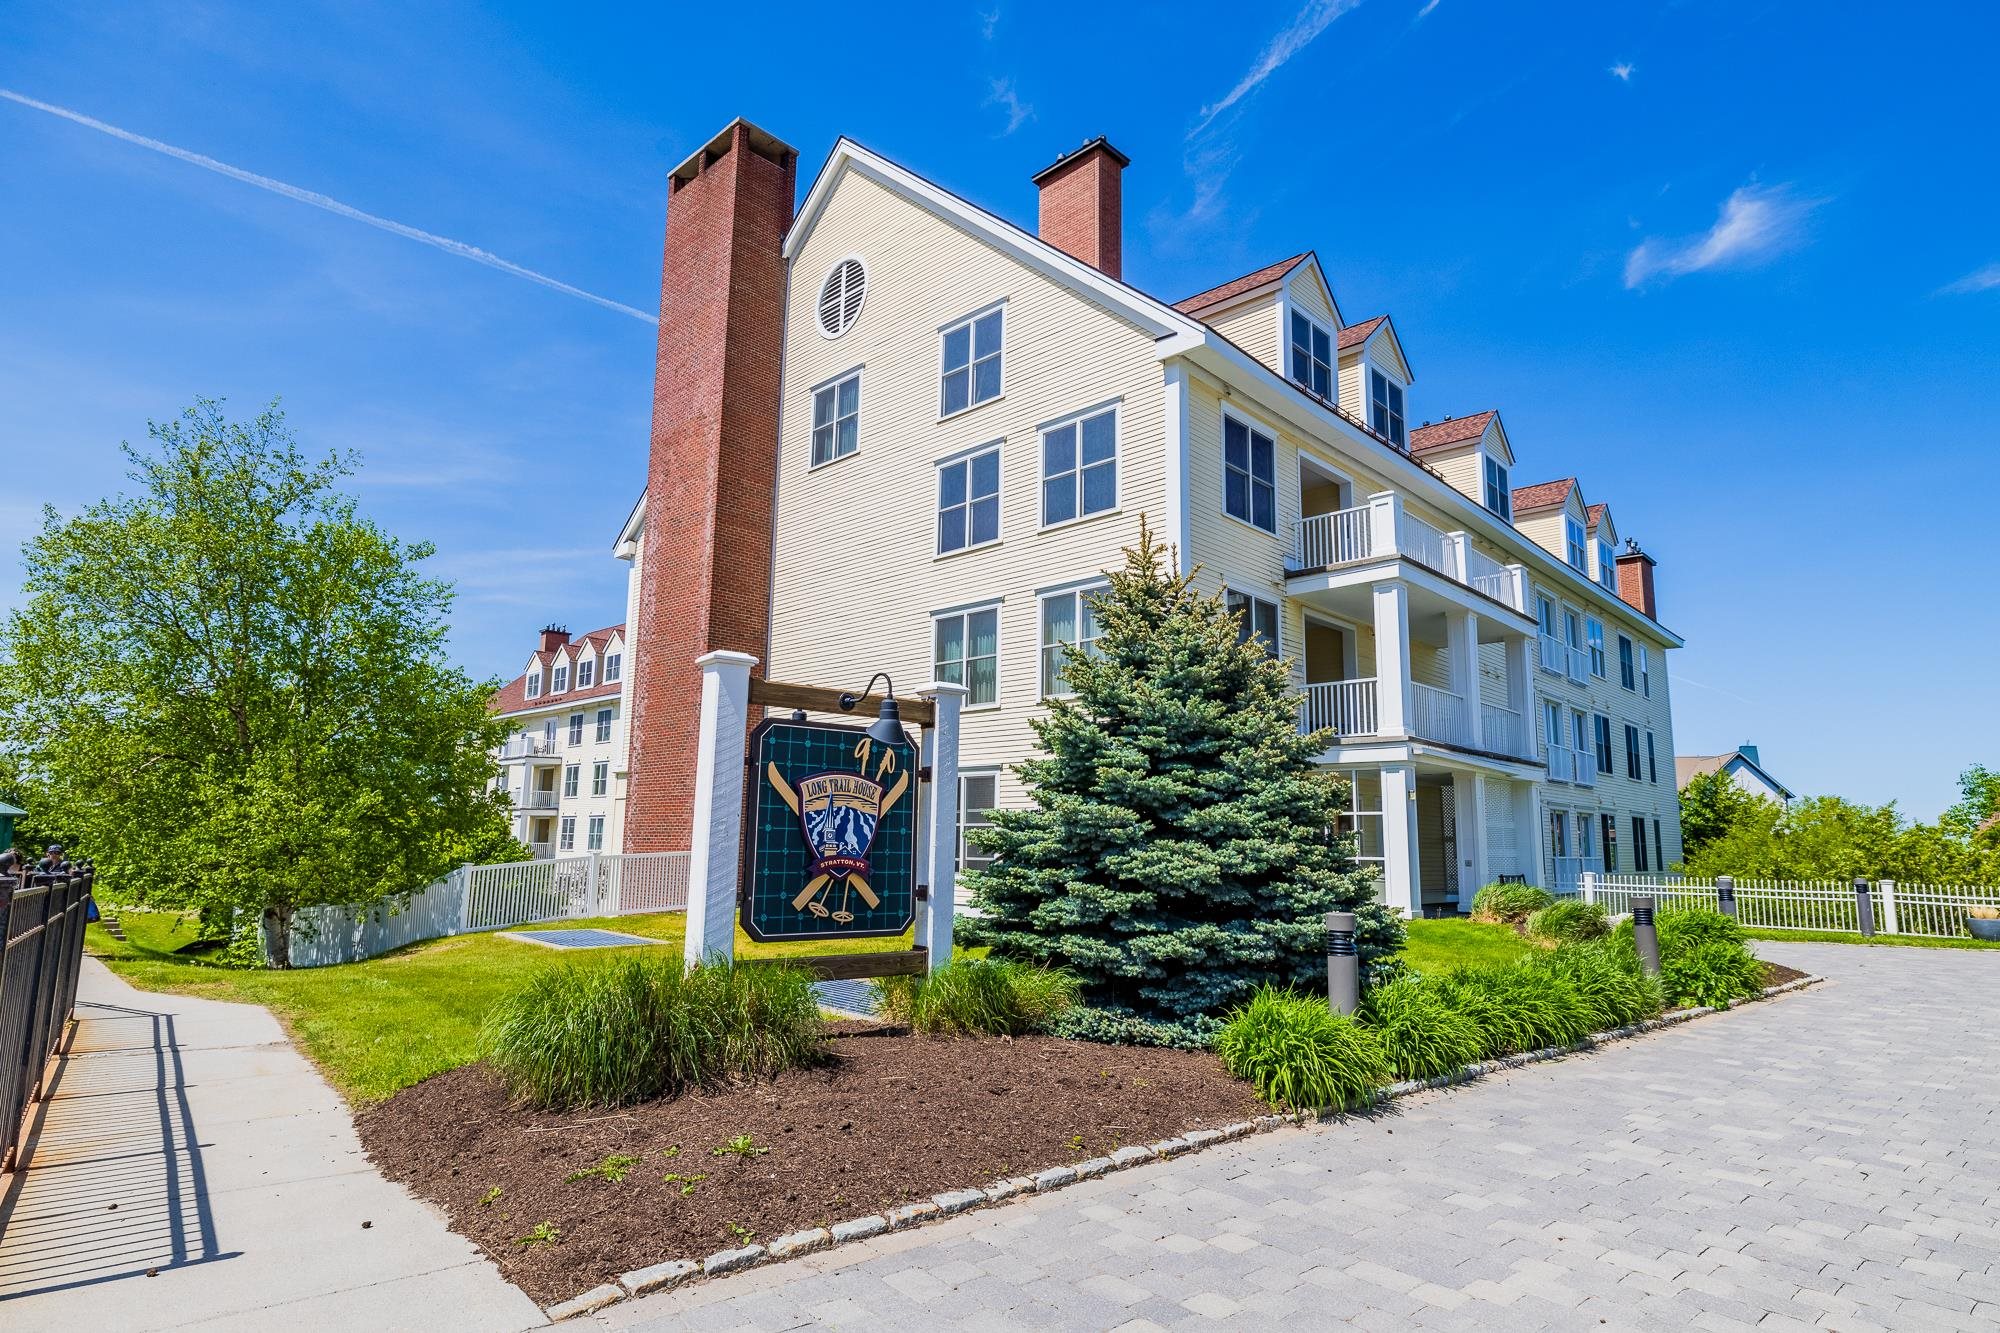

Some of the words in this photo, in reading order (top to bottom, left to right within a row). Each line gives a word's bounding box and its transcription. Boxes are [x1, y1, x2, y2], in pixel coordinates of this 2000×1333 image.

[806, 779, 828, 797] LONG
[829, 778, 852, 794] TRAIL
[853, 780, 877, 800] HOUSE
